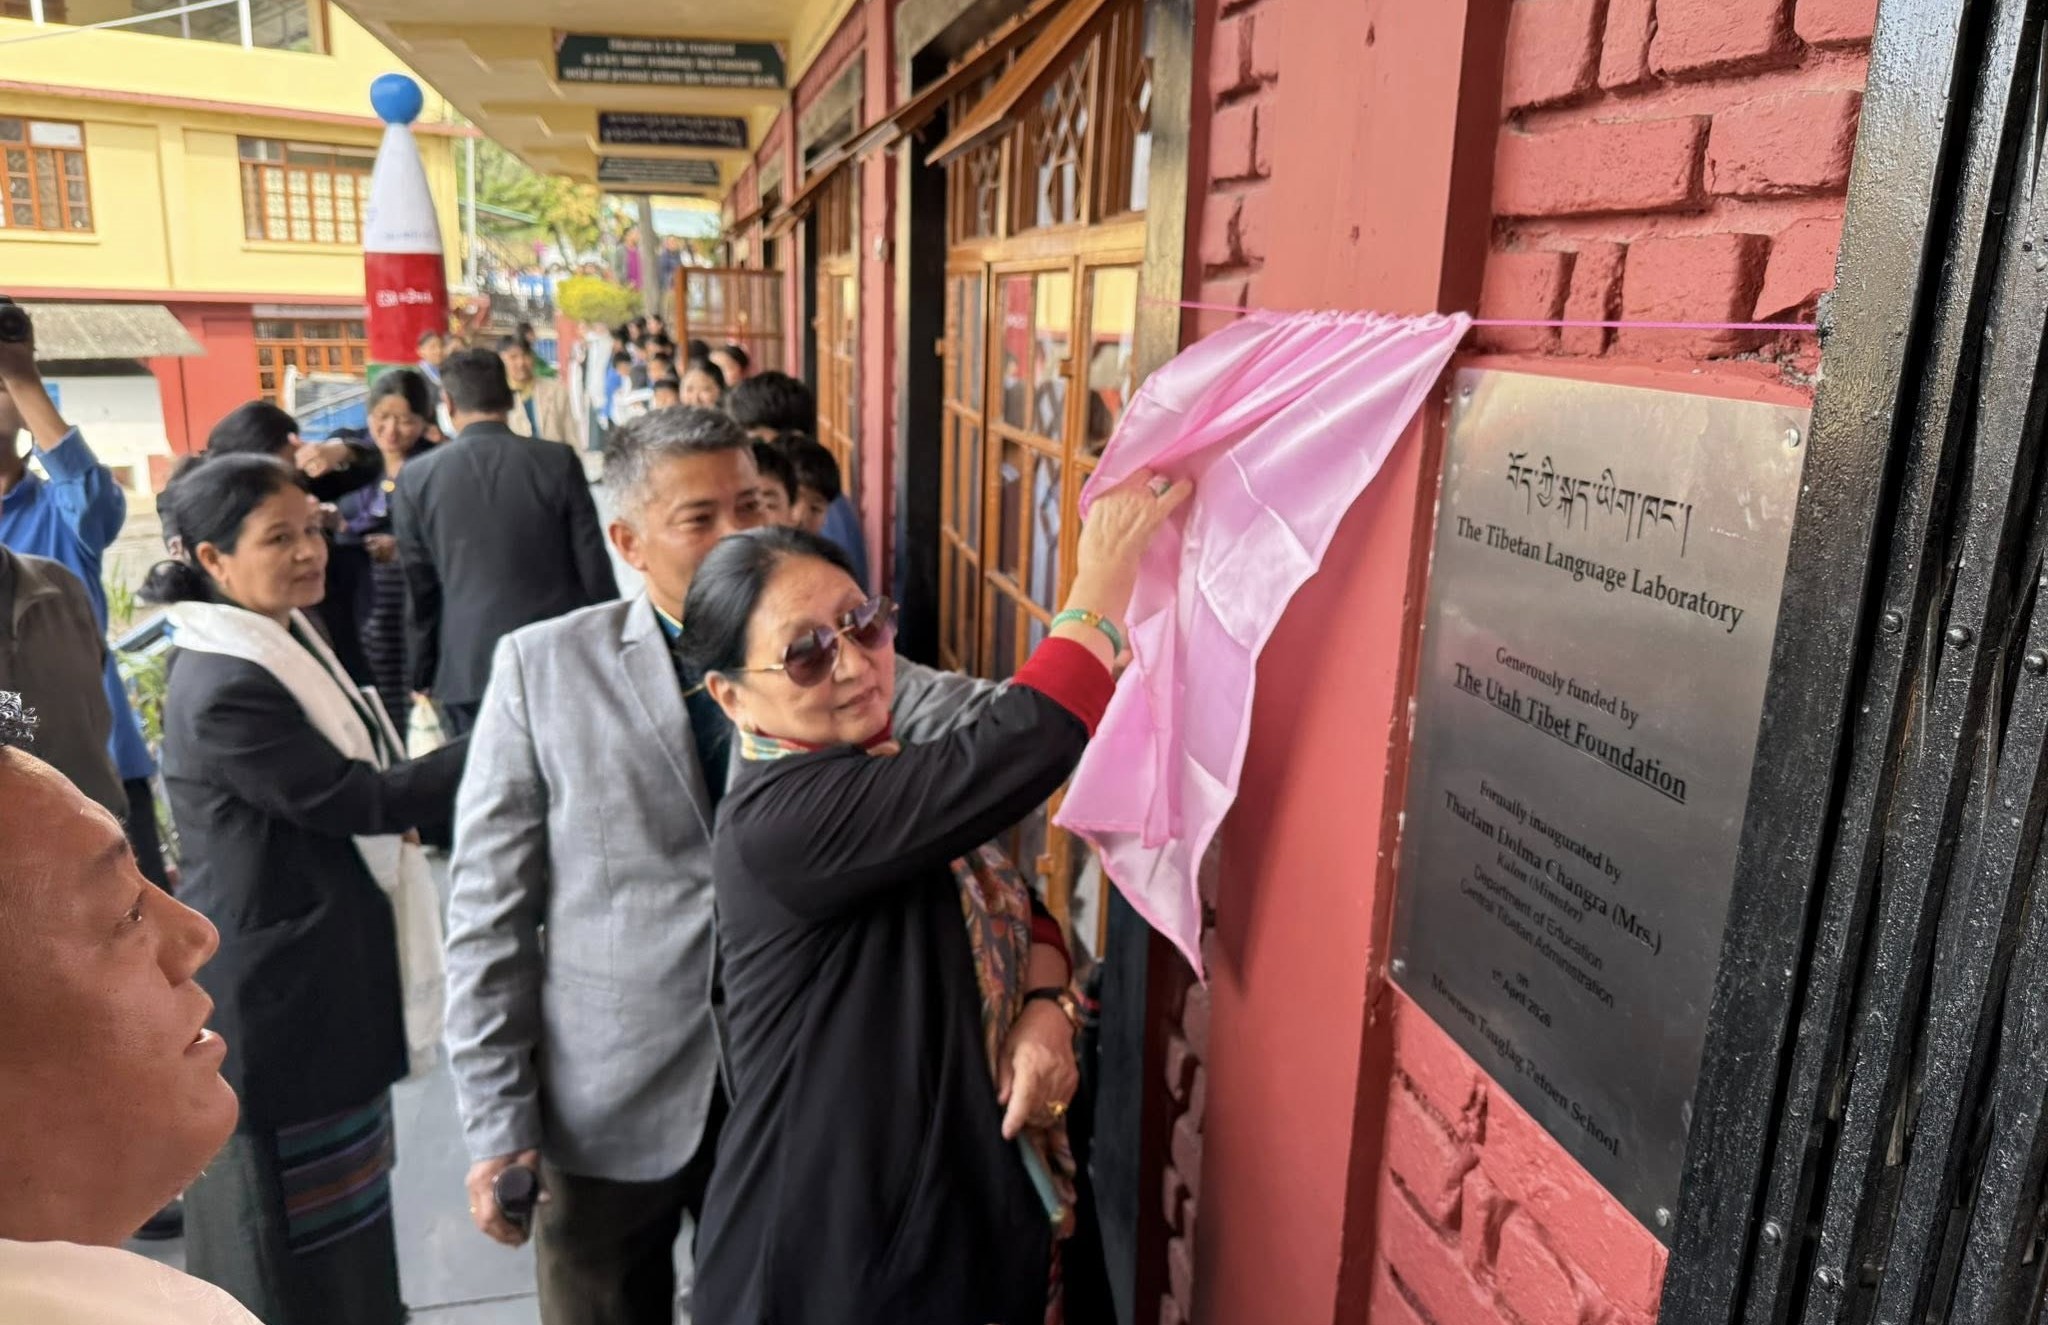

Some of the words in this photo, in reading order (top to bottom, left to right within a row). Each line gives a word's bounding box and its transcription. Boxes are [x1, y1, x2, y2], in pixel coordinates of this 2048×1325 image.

[1457, 517, 1482, 540] The
[1486, 526, 1540, 560] Tibetan
[1545, 543, 1626, 591] Language
[1631, 569, 1744, 633] Laboratory
[1455, 663, 1482, 693] The
[1486, 679, 1521, 714] Utah
[1525, 698, 1571, 738] Tibet
[1574, 723, 1686, 799] Foundation
[1496, 648, 1565, 694] Generously
[1567, 679, 1617, 714] funded
[1620, 702, 1639, 729] by
[1445, 791, 1494, 837] Tharlam
[1498, 827, 1541, 868] Dolma
[1545, 860, 1607, 915] Changra
[1612, 905, 1662, 955] (Mrs.)
[1480, 781, 1527, 824] Formally
[1529, 812, 1603, 869] inaugurated
[1605, 858, 1622, 884] by
[1474, 865, 1531, 916] Department
[1533, 913, 1546, 926] of
[1547, 919, 1603, 970] Education
[1572, 1103, 1619, 1156] School
